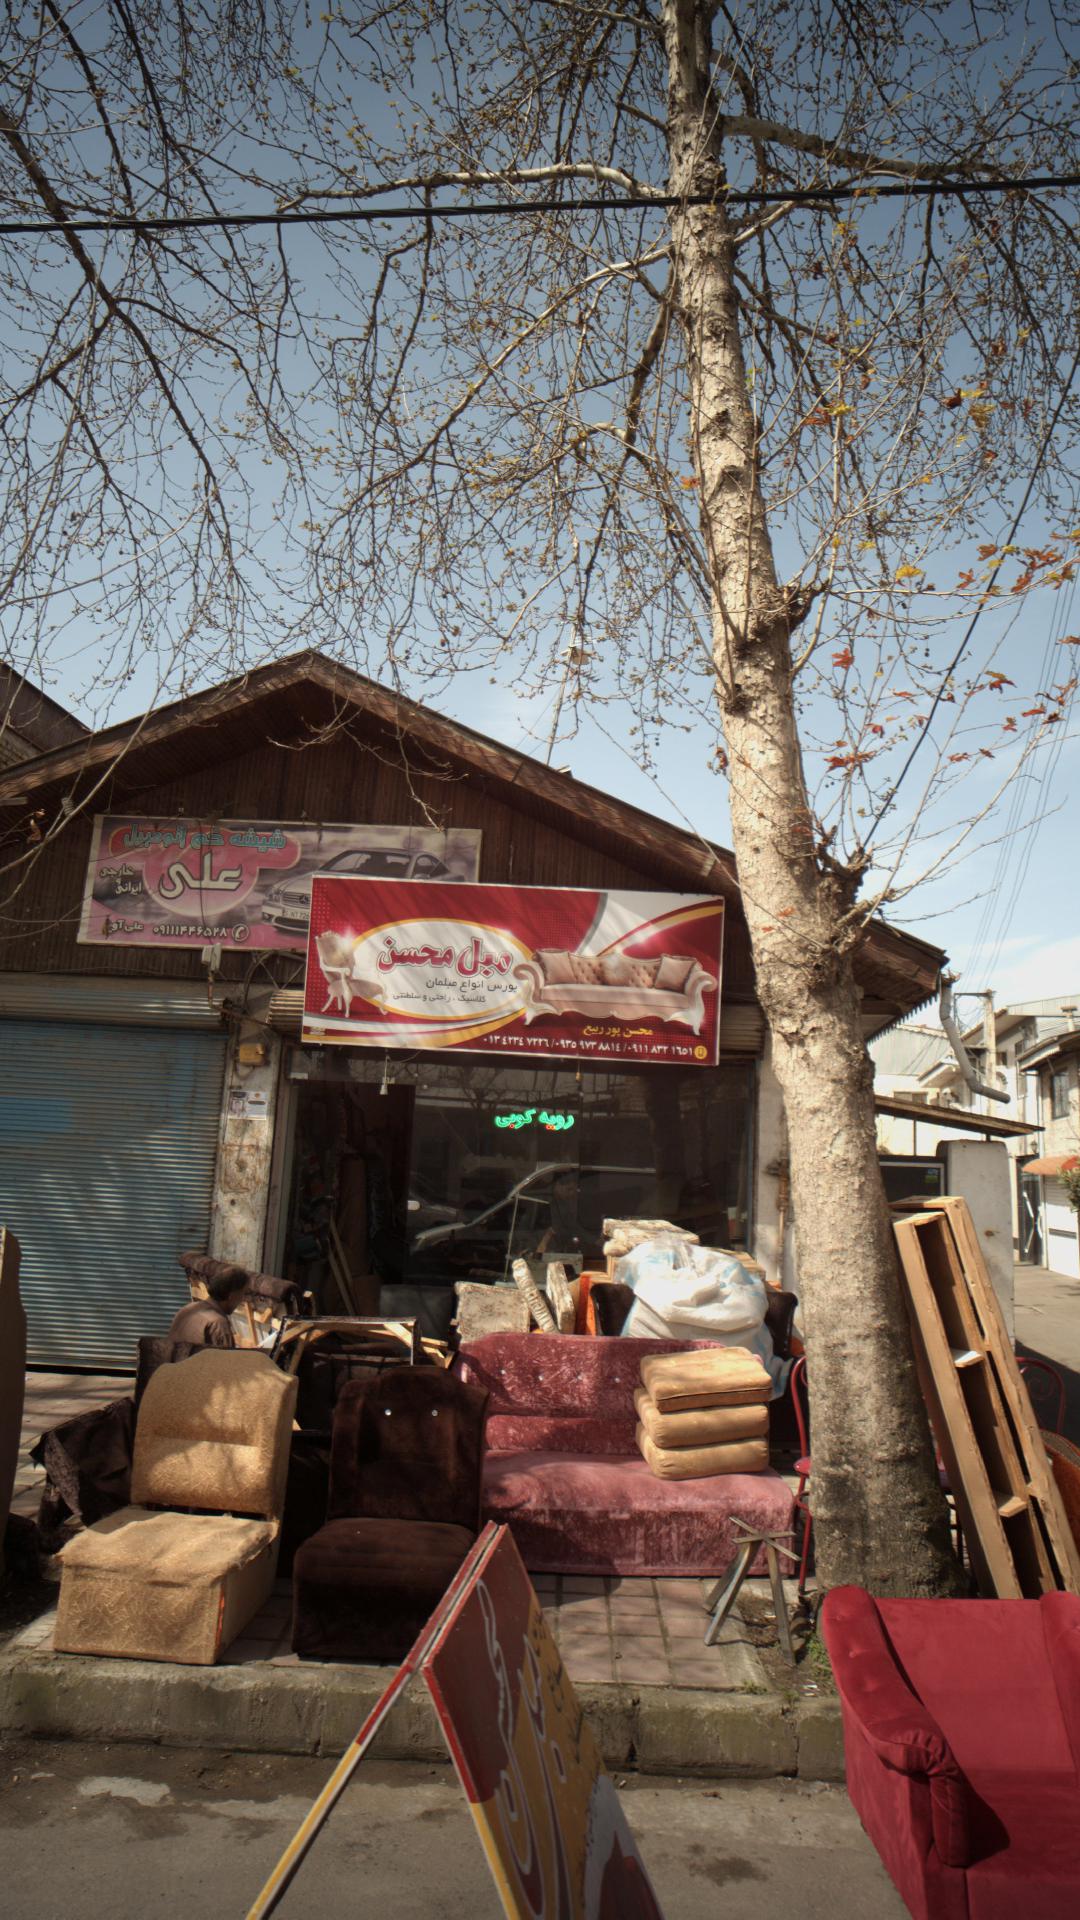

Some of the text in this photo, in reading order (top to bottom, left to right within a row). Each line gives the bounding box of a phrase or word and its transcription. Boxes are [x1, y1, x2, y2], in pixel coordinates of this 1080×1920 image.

[229, 827, 286, 853] شیشه
[100, 863, 134, 877] خارجی
[158, 850, 243, 900] علی
[115, 881, 142, 896] ایرانی
[376, 936, 513, 978] مبل محسن
[426, 977, 457, 989] مبلمان
[459, 979, 484, 993] انواع
[623, 1027, 654, 1038] محسن
[494, 1108, 575, 1131] رویه کوبی
